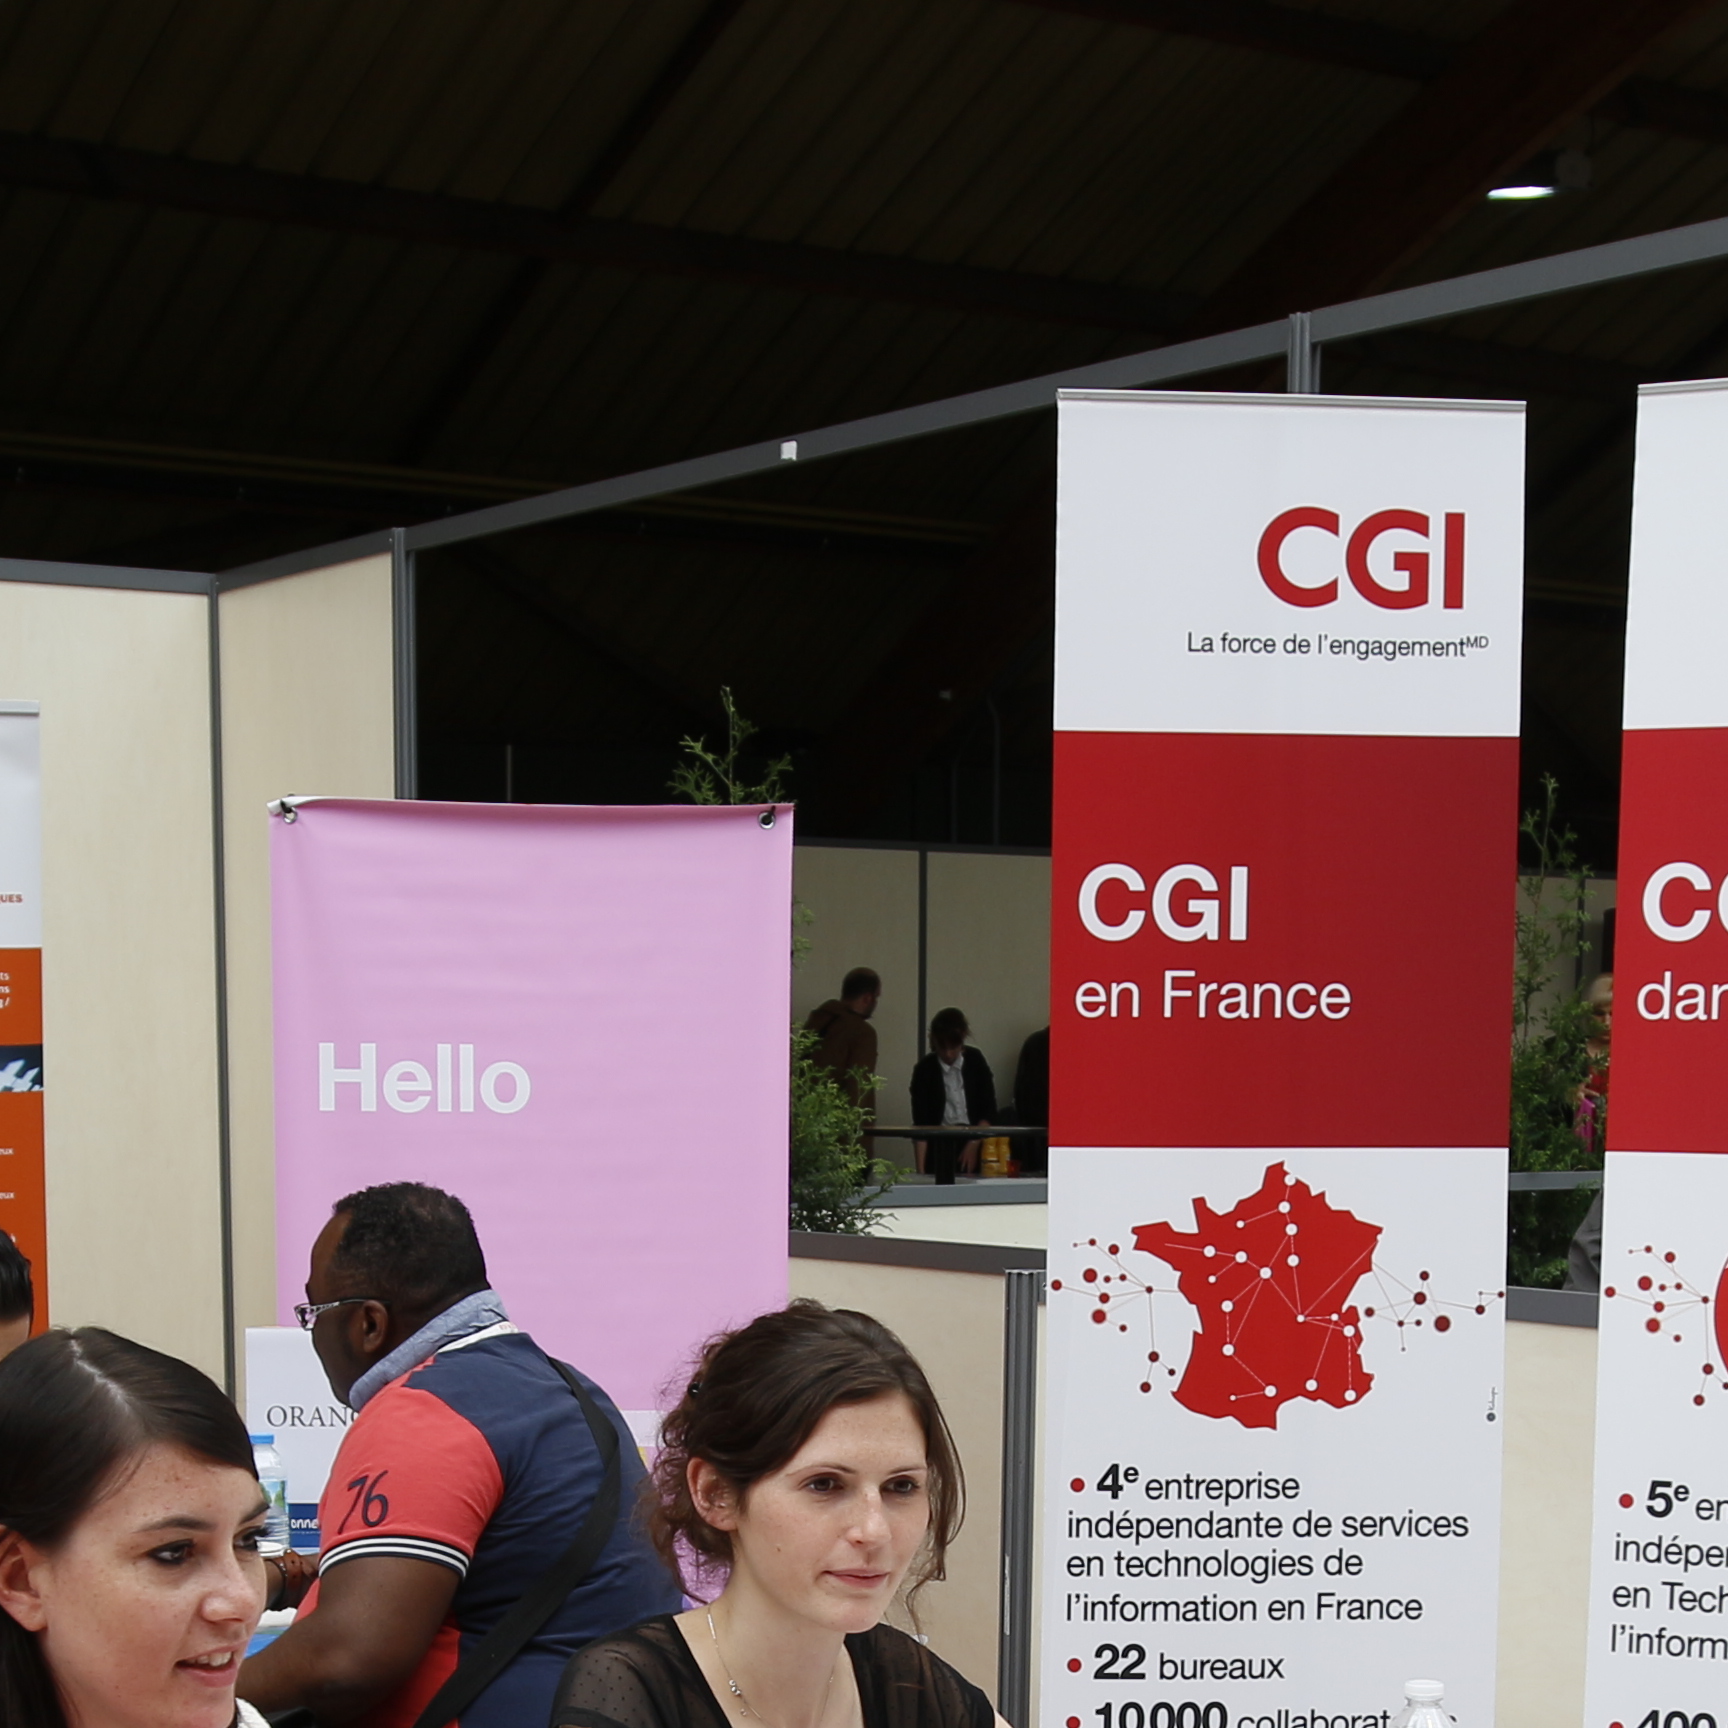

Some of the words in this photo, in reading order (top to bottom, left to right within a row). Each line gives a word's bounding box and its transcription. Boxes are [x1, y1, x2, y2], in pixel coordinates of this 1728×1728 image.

[1257, 506, 1465, 609] CGI
[1187, 633, 1213, 654] La
[1221, 632, 1276, 655] force
[1284, 634, 1310, 655] de
[1078, 863, 1249, 942] CGI
[1075, 979, 1140, 1019] en
[1164, 970, 1351, 1020] France
[318, 1042, 531, 1114] Hello
[338, 1470, 388, 1534] 76
[1145, 1470, 1300, 1504] entreprise
[1067, 1510, 1283, 1545] indépendante
[1292, 1511, 1332, 1538] de
[1341, 1509, 1469, 1537] services
[1067, 1552, 1103, 1578] en
[1115, 1549, 1313, 1583] technologies
[1324, 1549, 1363, 1575] de
[1066, 1595, 1257, 1622] l'information
[1268, 1596, 1306, 1621] en
[1317, 1593, 1423, 1620] France
[1613, 1584, 1650, 1609] en
[1094, 1644, 1146, 1681] 22
[1159, 1652, 1284, 1680] bureaux
